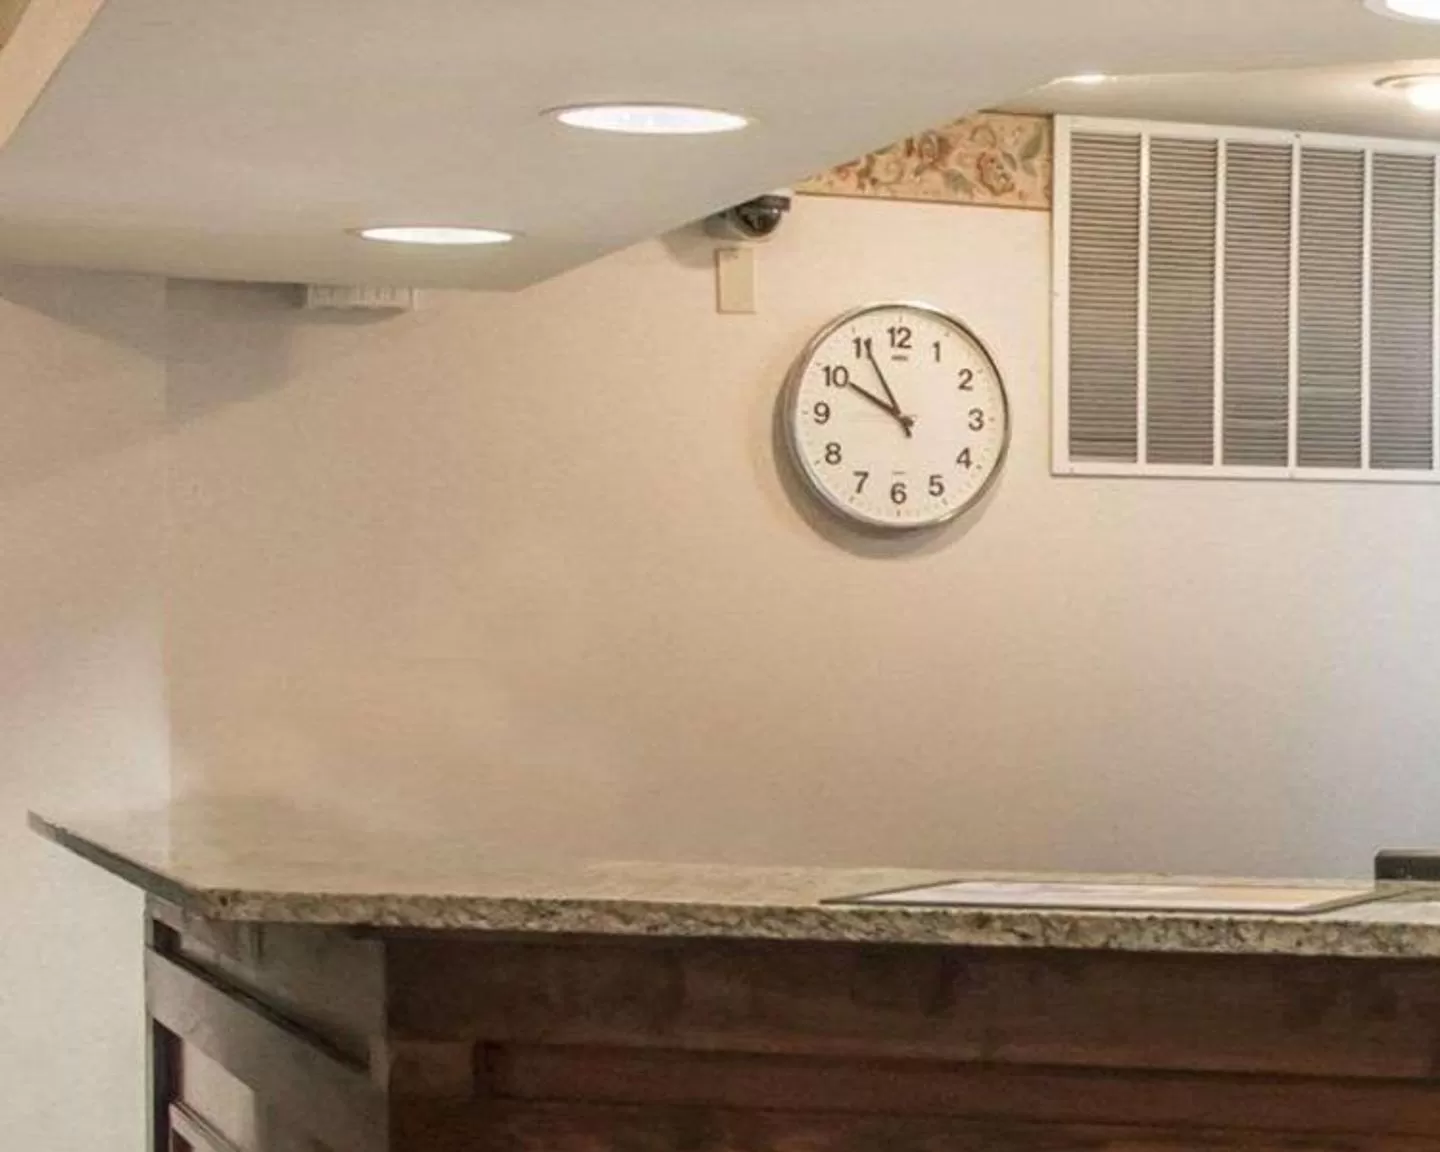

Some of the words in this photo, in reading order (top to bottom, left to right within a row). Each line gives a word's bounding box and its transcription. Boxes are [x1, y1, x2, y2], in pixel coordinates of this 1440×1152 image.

[853, 337, 872, 359] 11
[887, 327, 912, 349] 12
[932, 341, 940, 362] 1
[823, 366, 849, 387] 10
[958, 368, 974, 391] 2
[813, 402, 830, 425] 9
[968, 408, 984, 431] 3
[825, 442, 842, 465] 8
[956, 447, 972, 469] 4
[853, 471, 869, 494] 7
[890, 482, 907, 504] 6
[928, 475, 945, 497] 5
